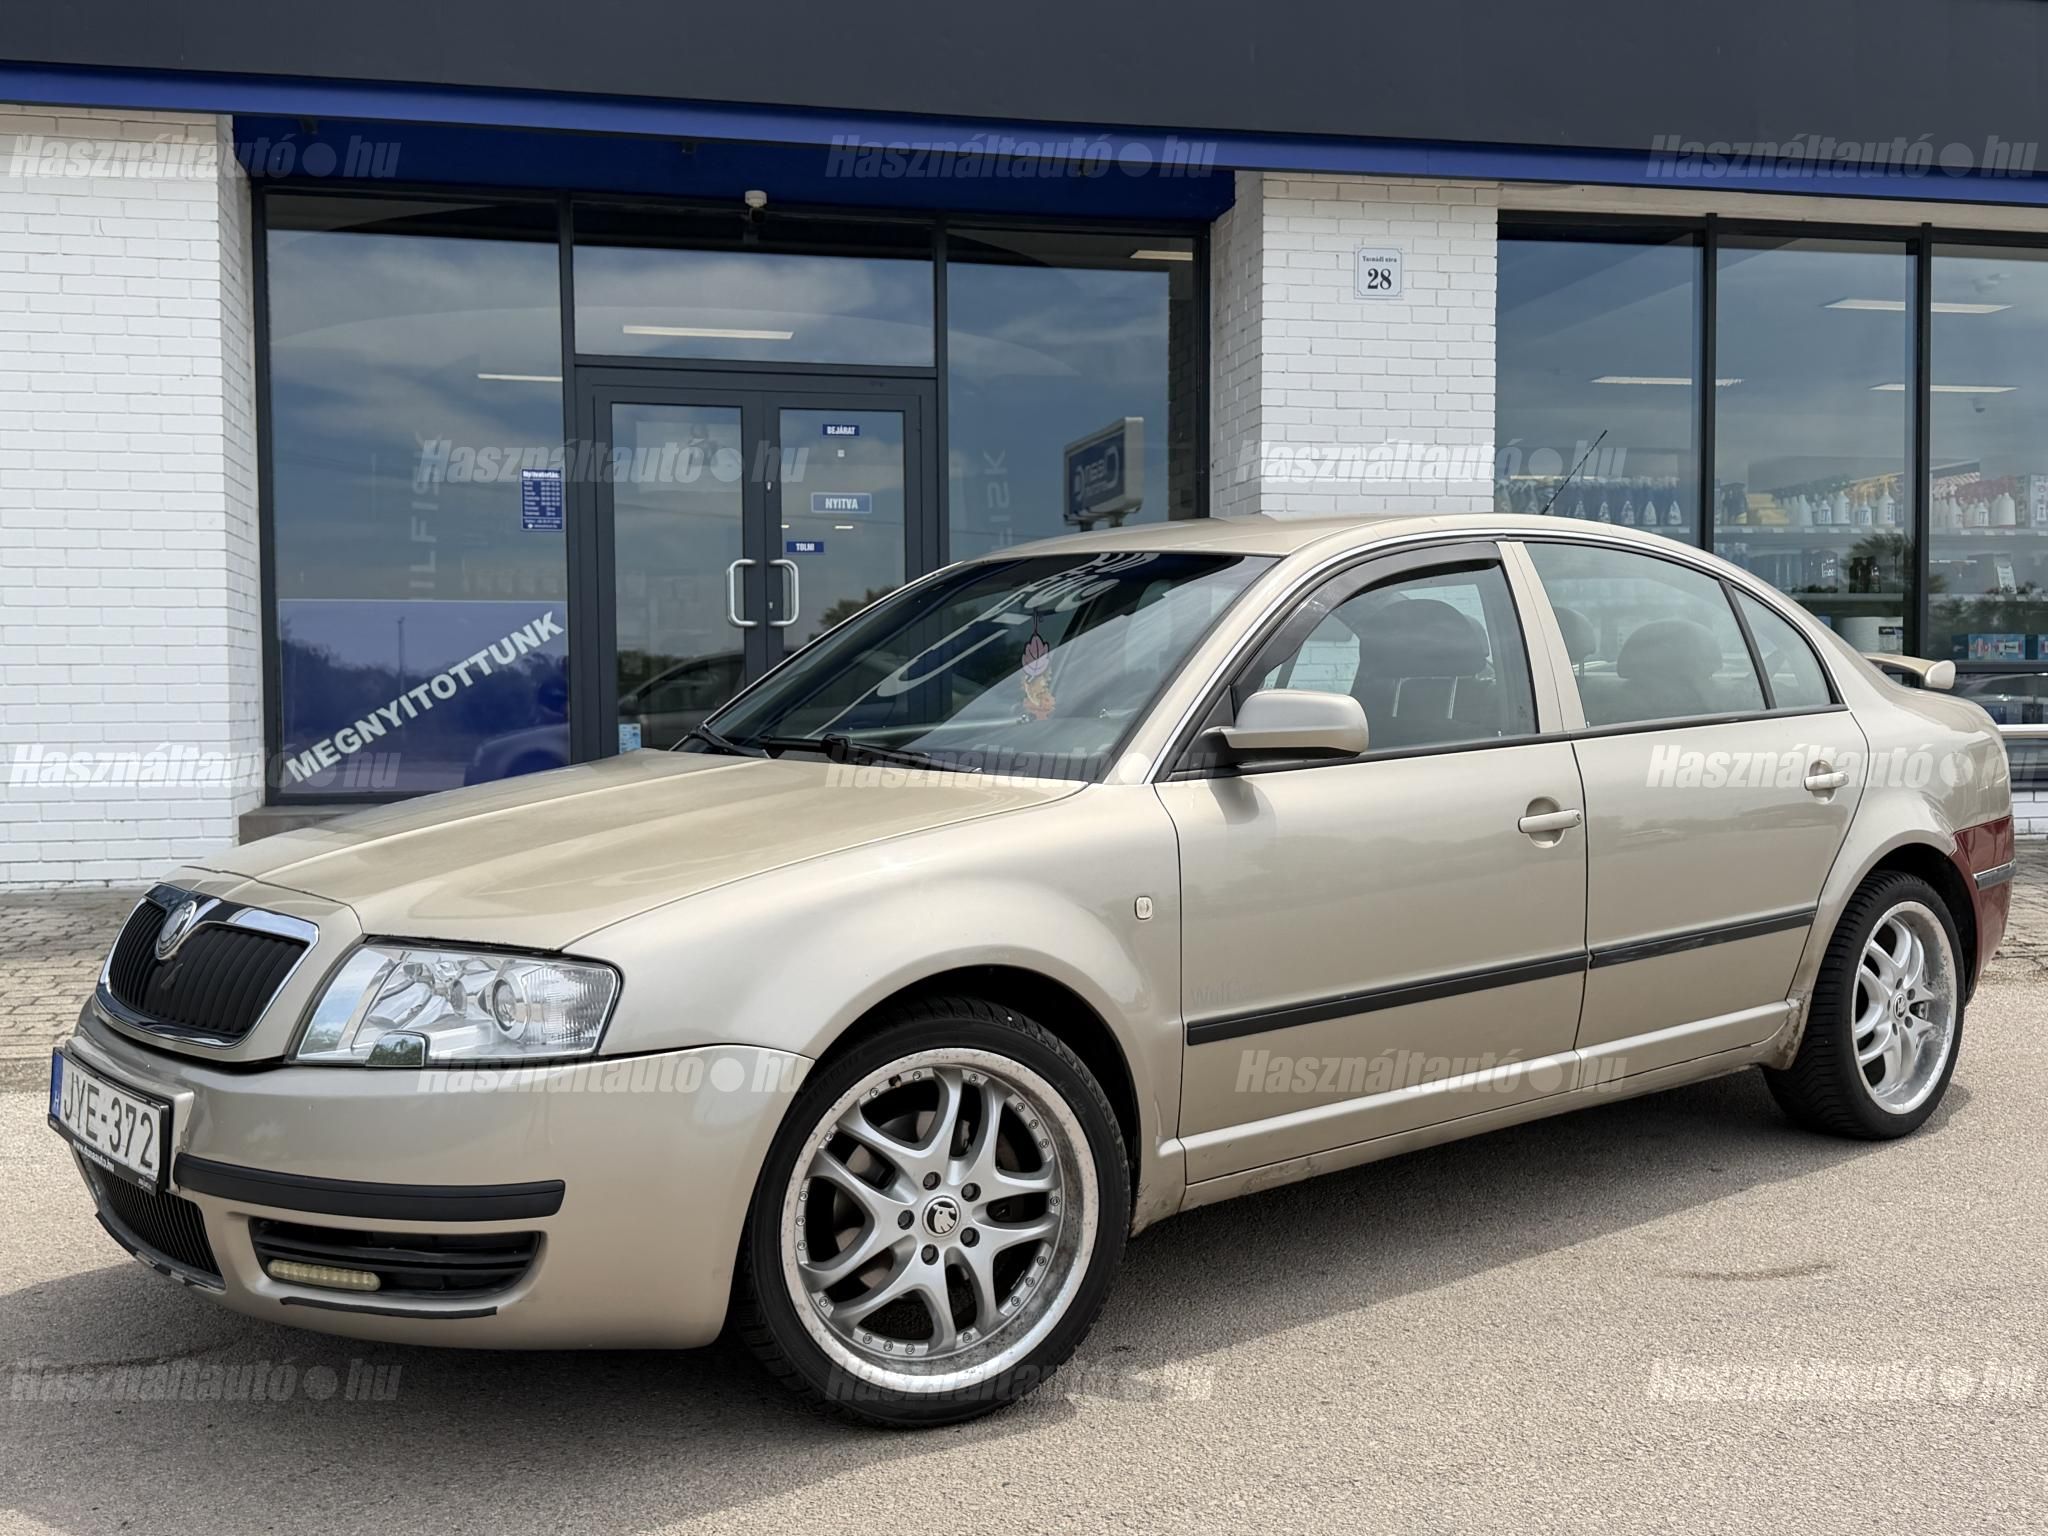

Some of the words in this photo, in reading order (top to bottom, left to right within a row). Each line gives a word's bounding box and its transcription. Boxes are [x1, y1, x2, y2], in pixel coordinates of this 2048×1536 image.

[1367, 268, 1392, 290] 28
[826, 424, 856, 435] BEJÁRAT
[824, 497, 859, 510] NYITVA
[285, 611, 565, 783] MEGNYITOTTUNK
[63, 1071, 154, 1170] JYE-372
